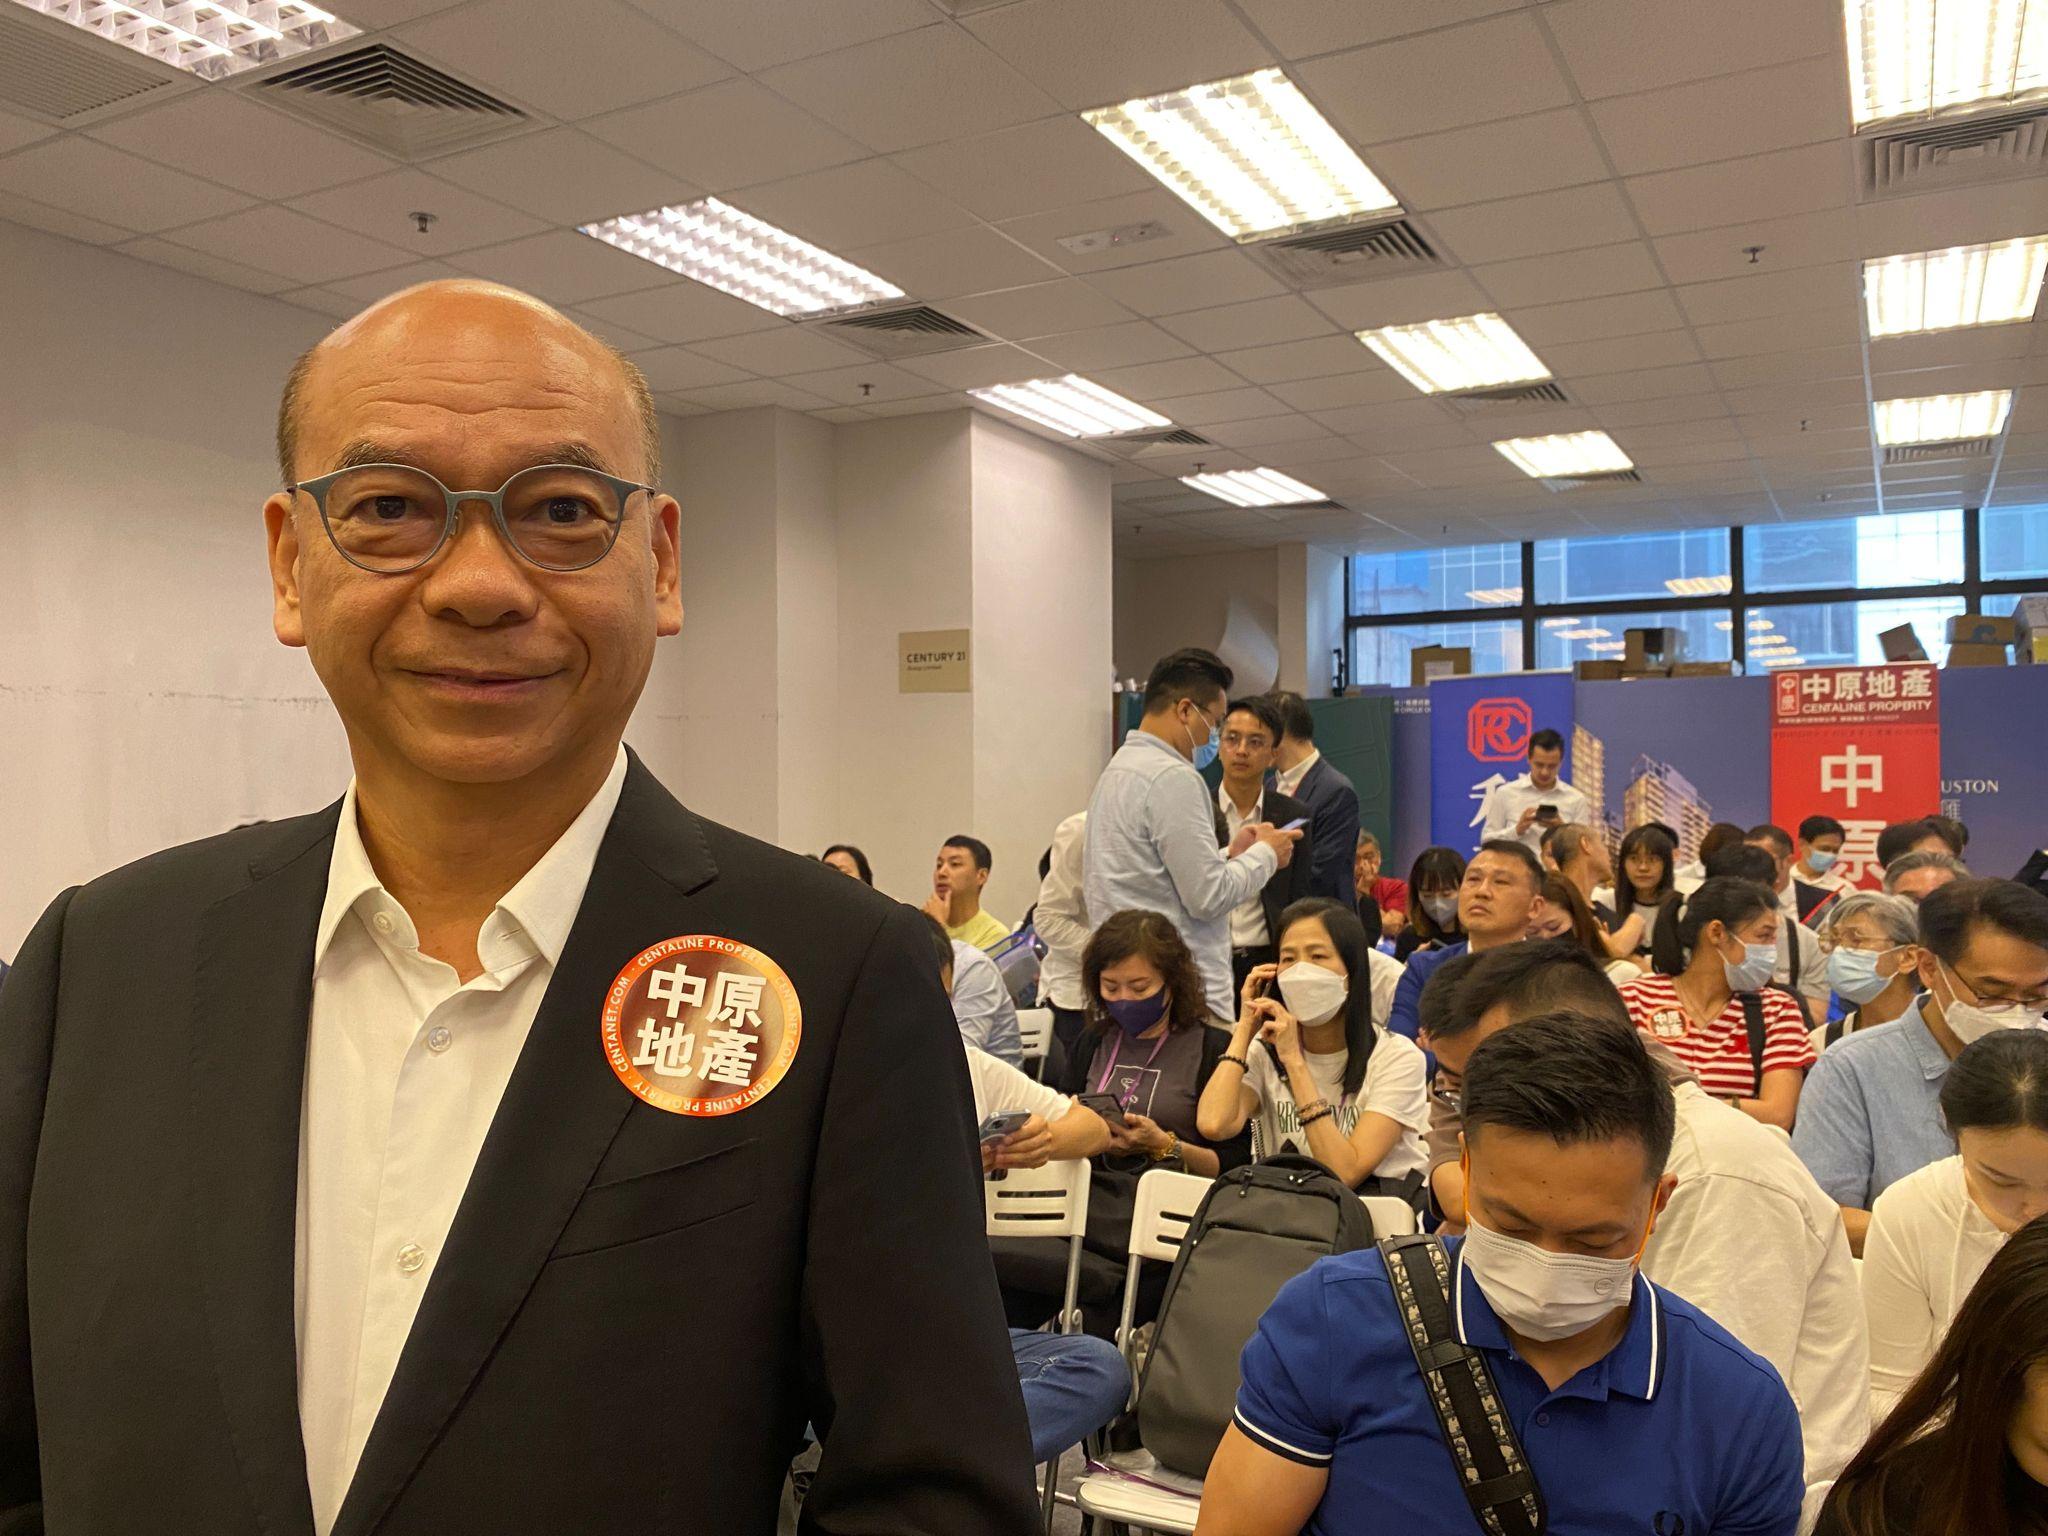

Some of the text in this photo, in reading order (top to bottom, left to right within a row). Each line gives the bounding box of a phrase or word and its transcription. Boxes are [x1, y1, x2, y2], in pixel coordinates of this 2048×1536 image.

[906, 651, 966, 663] CENTURY 21
[1802, 668, 1933, 702] 中原地產
[1802, 700, 1932, 714] CENTALINE PROPERTY
[637, 938, 704, 967] CENTALINE
[647, 963, 767, 1028] 中原
[606, 976, 630, 1073] CENTANET.COM
[632, 1017, 759, 1087] 地產
[633, 1078, 772, 1114] CENTALINE PRORTY
